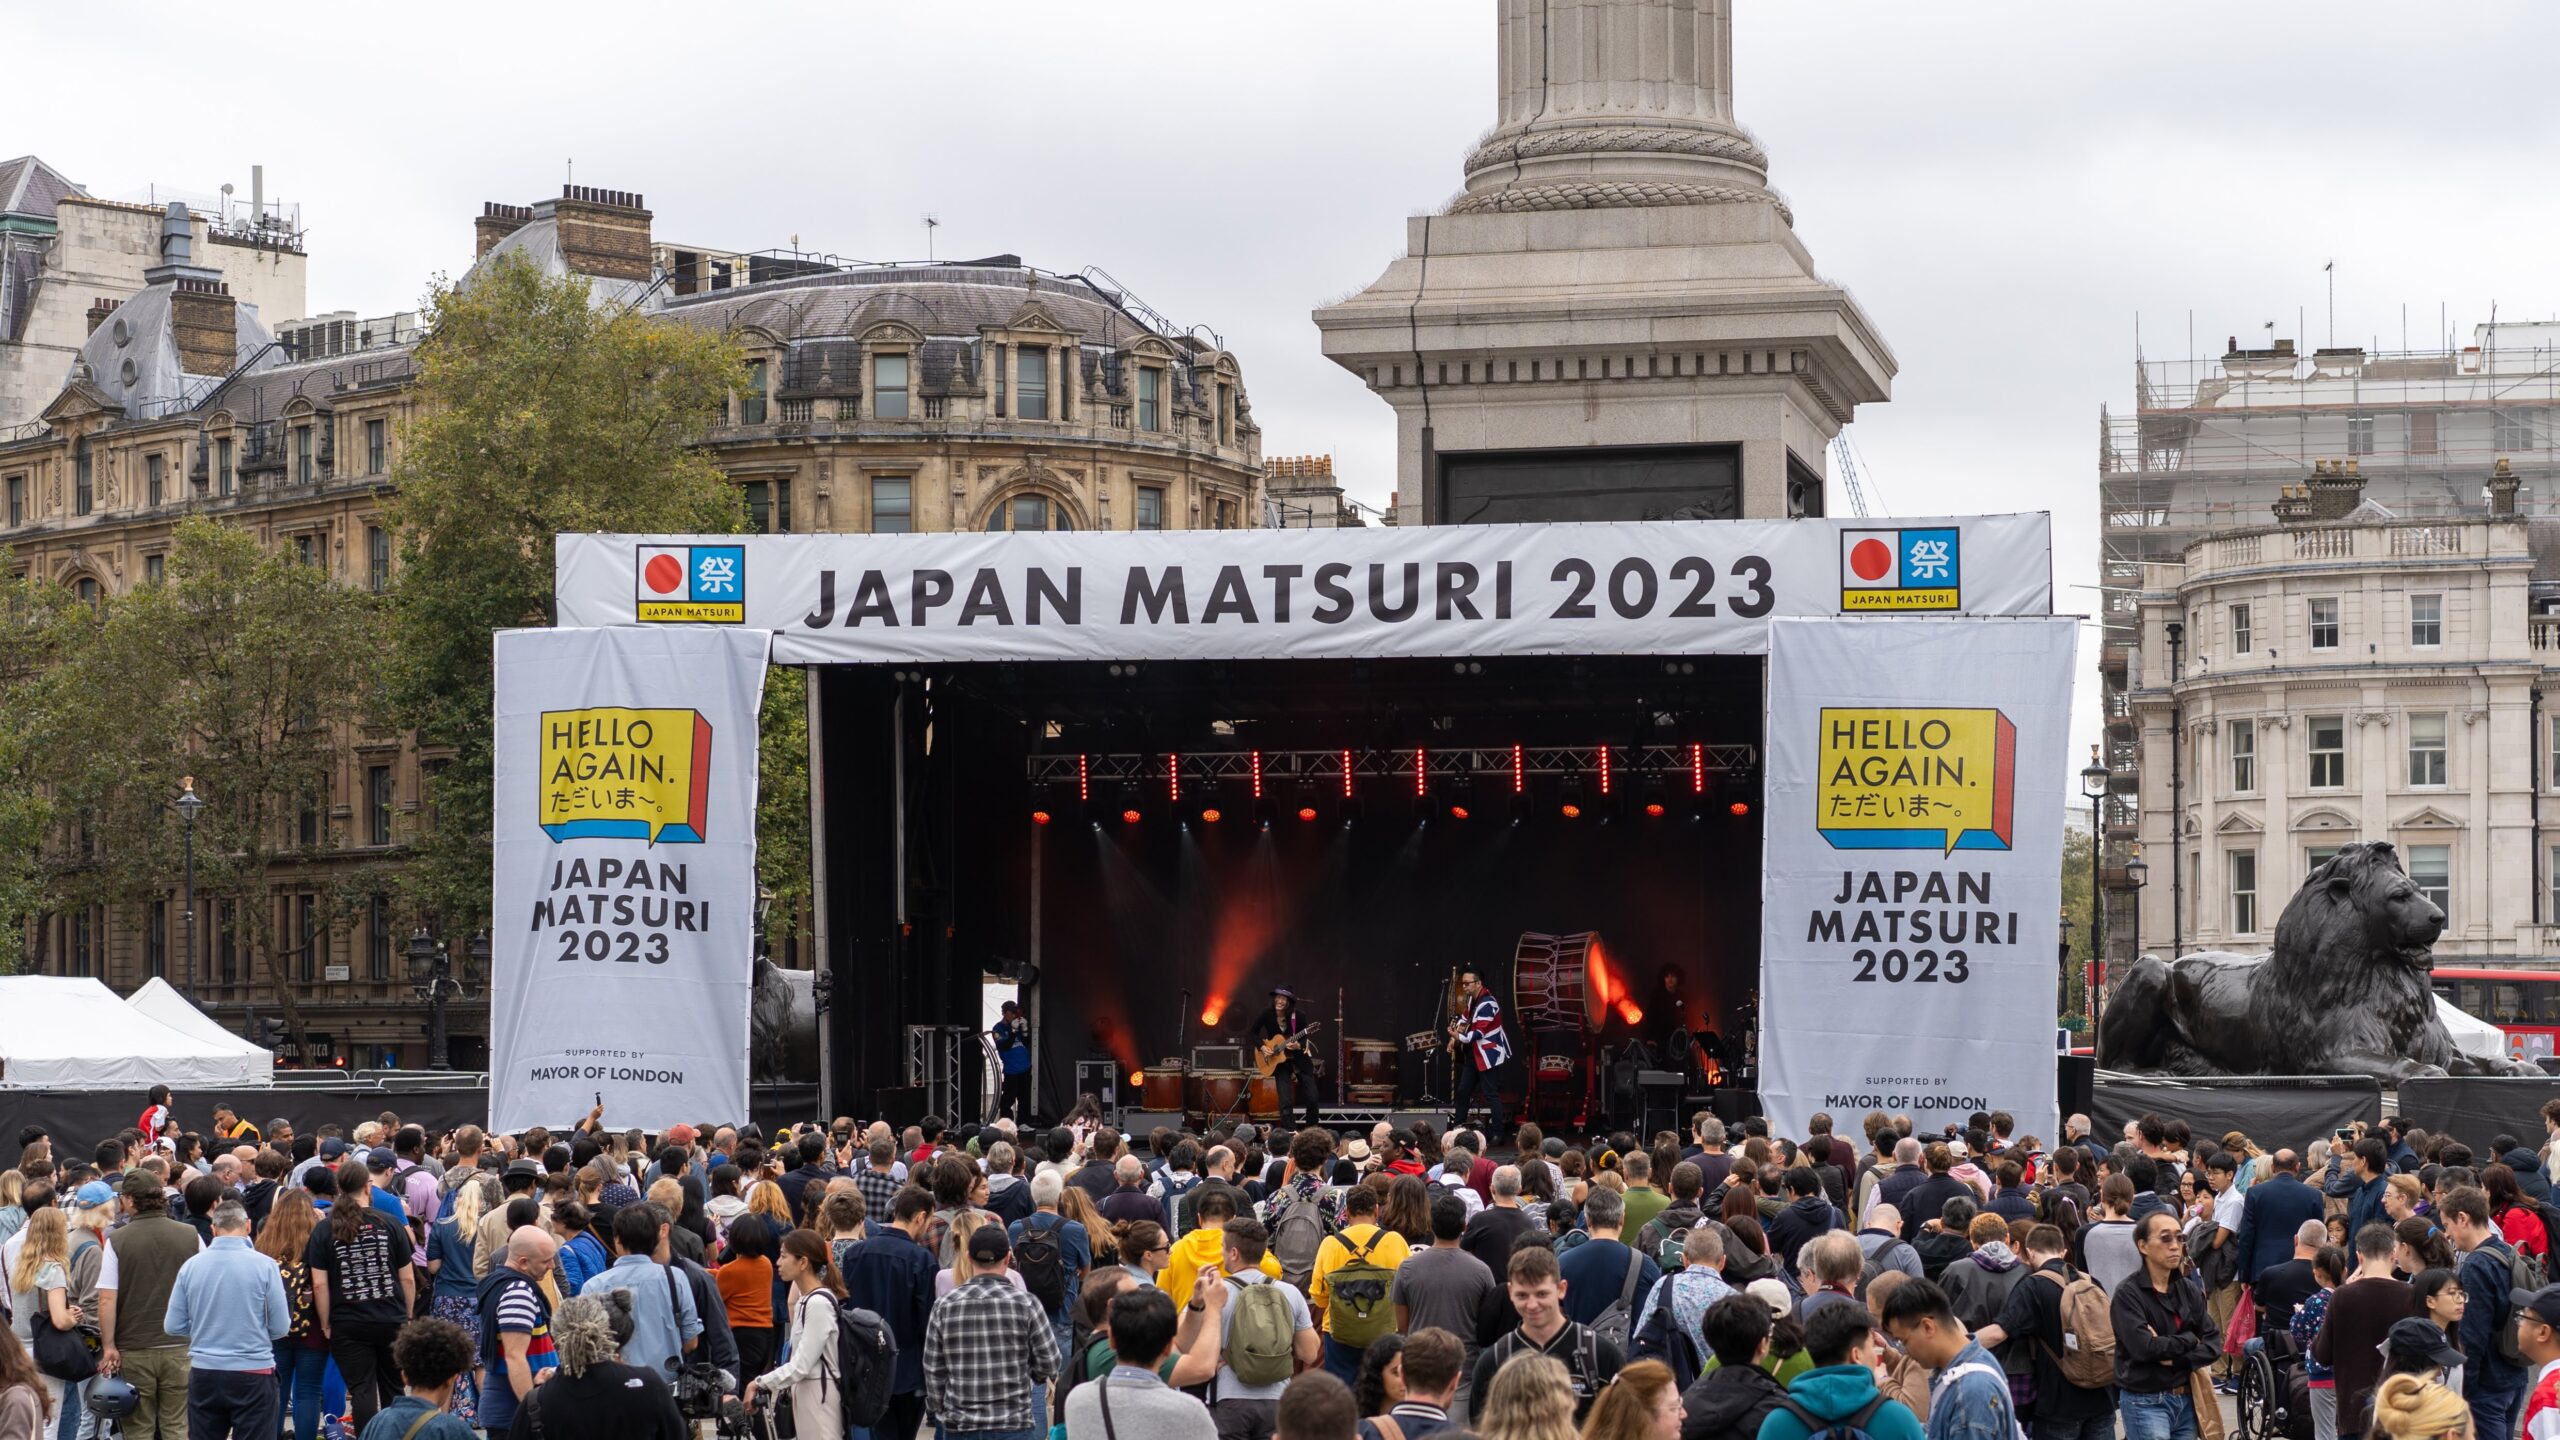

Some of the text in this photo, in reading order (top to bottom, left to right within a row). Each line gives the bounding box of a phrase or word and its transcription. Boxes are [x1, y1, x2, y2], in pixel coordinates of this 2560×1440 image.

[699, 557, 734, 592] 祭
[1911, 541, 1948, 577] 祭
[804, 556, 1774, 629] JAPAN MATSURI 2023
[1852, 595, 1950, 604] JAPAN MATSURI
[646, 608, 735, 617] JAPAN MATSURI
[553, 719, 652, 749] HELLO
[1833, 720, 1950, 749] HELLO
[552, 752, 674, 784] AGAIN.
[1831, 756, 1975, 786] AGAIN.
[551, 859, 686, 894] JAPAN
[1834, 871, 1990, 904] JAPAN
[532, 895, 709, 932] MATSURI
[1807, 910, 2017, 944] MATSURI
[558, 931, 669, 964] 2023
[1853, 949, 1969, 983] 2023
[565, 1049, 645, 1059] SUPPORTED BY
[532, 1067, 682, 1084] MAYOR OF LONDON
[1865, 1076, 1948, 1086] SUPPORTED BY
[1826, 1095, 1986, 1110] MAYOR OF LONDON
